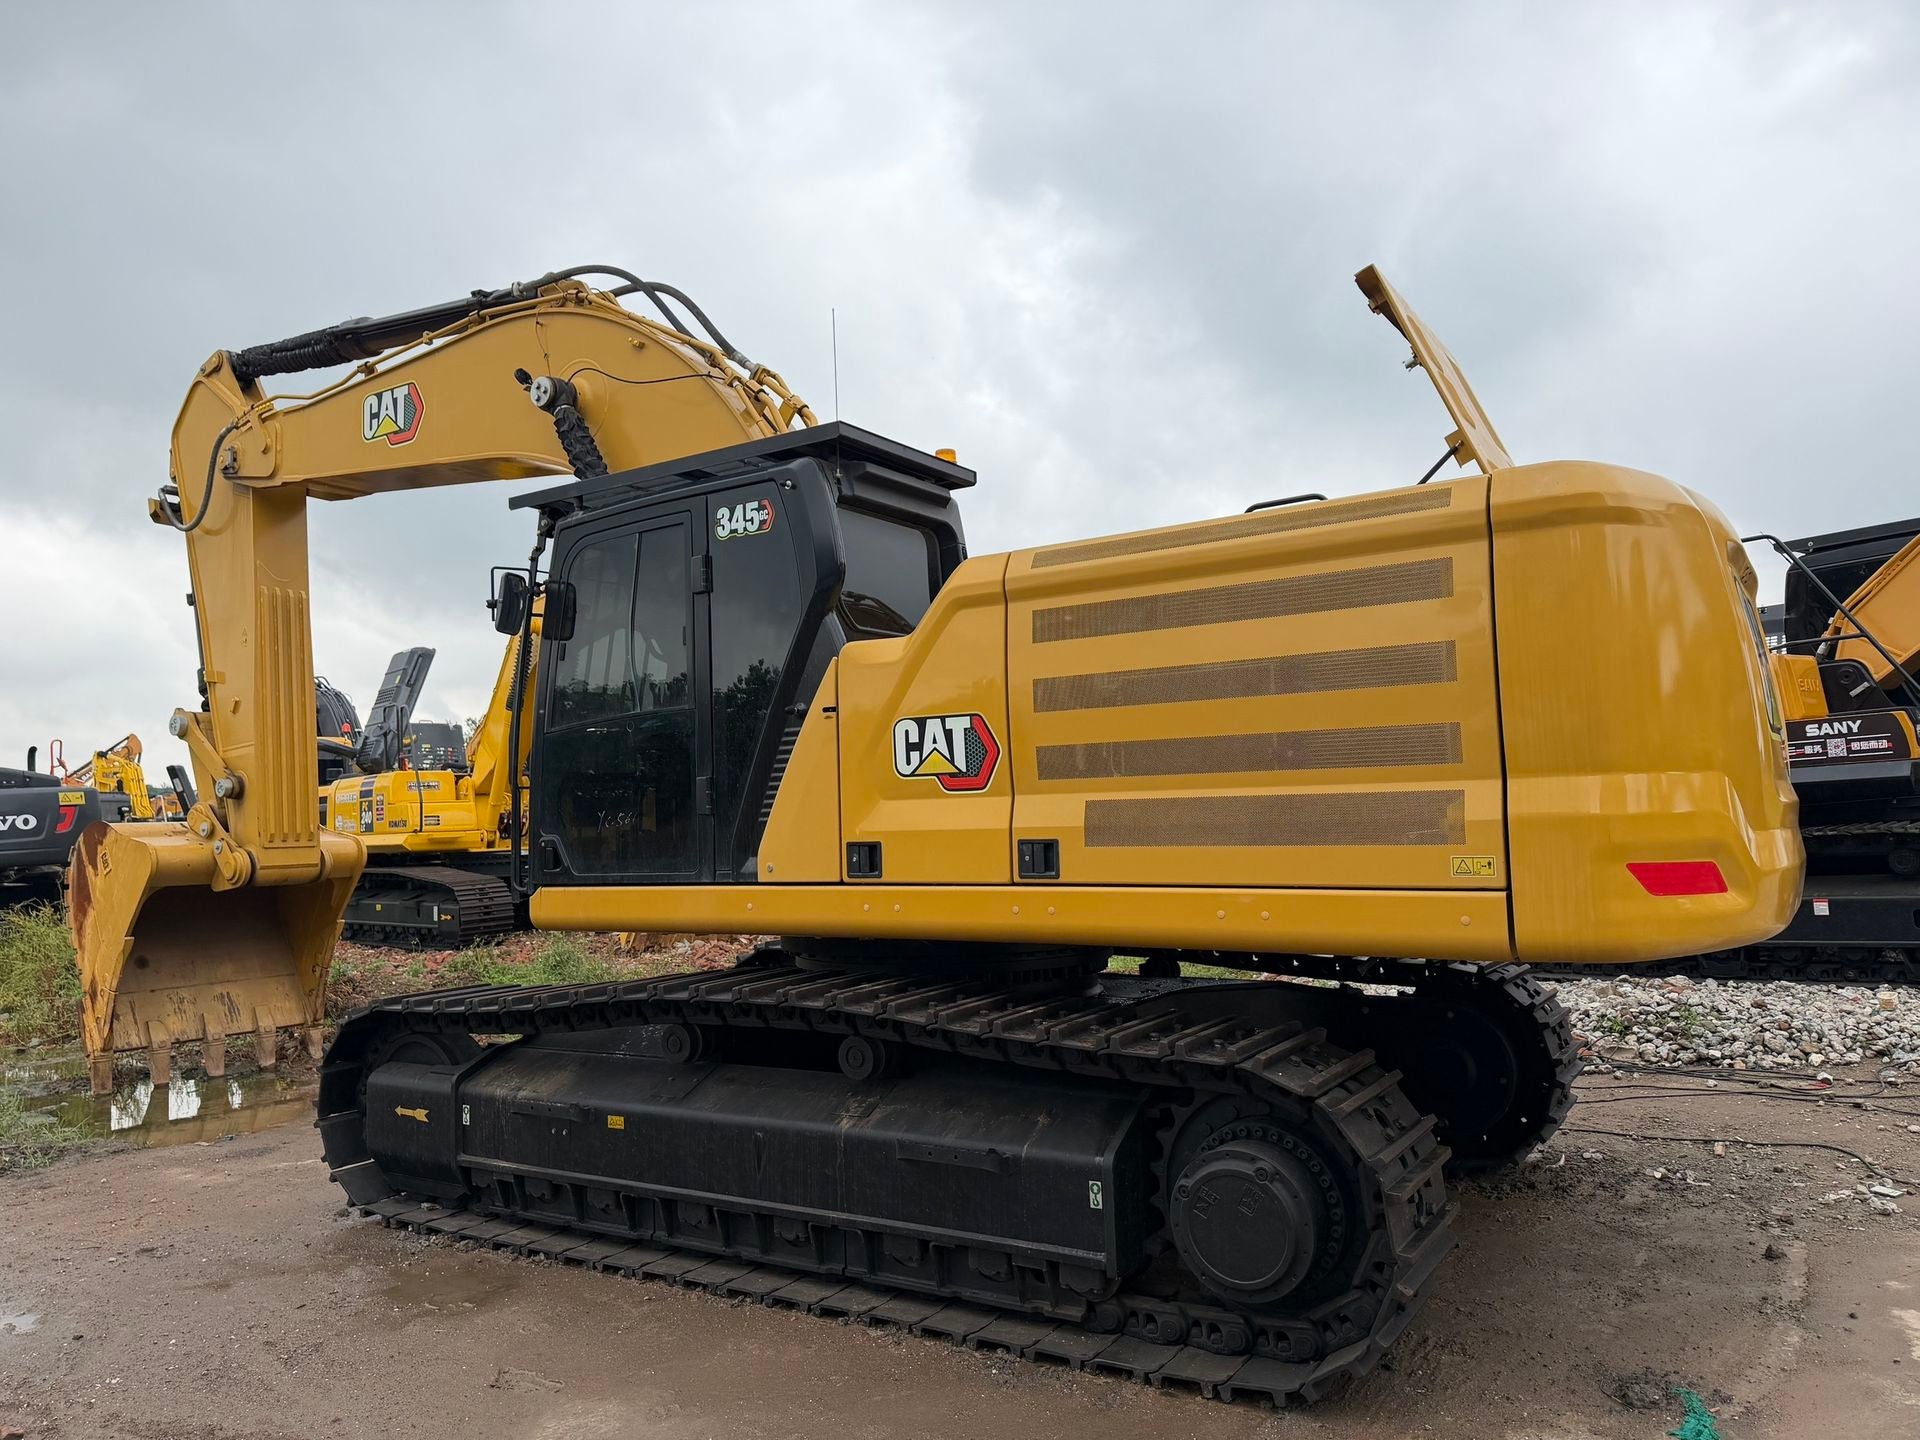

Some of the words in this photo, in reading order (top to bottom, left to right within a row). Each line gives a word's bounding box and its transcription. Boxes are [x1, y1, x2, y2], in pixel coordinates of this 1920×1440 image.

[363, 384, 409, 440] CAT
[716, 501, 760, 537] 345
[759, 509, 769, 520] GC
[1805, 719, 1862, 737] SANY
[894, 715, 971, 776] CAT
[361, 811, 373, 825] 240
[388, 818, 408, 828] KOMATSU
